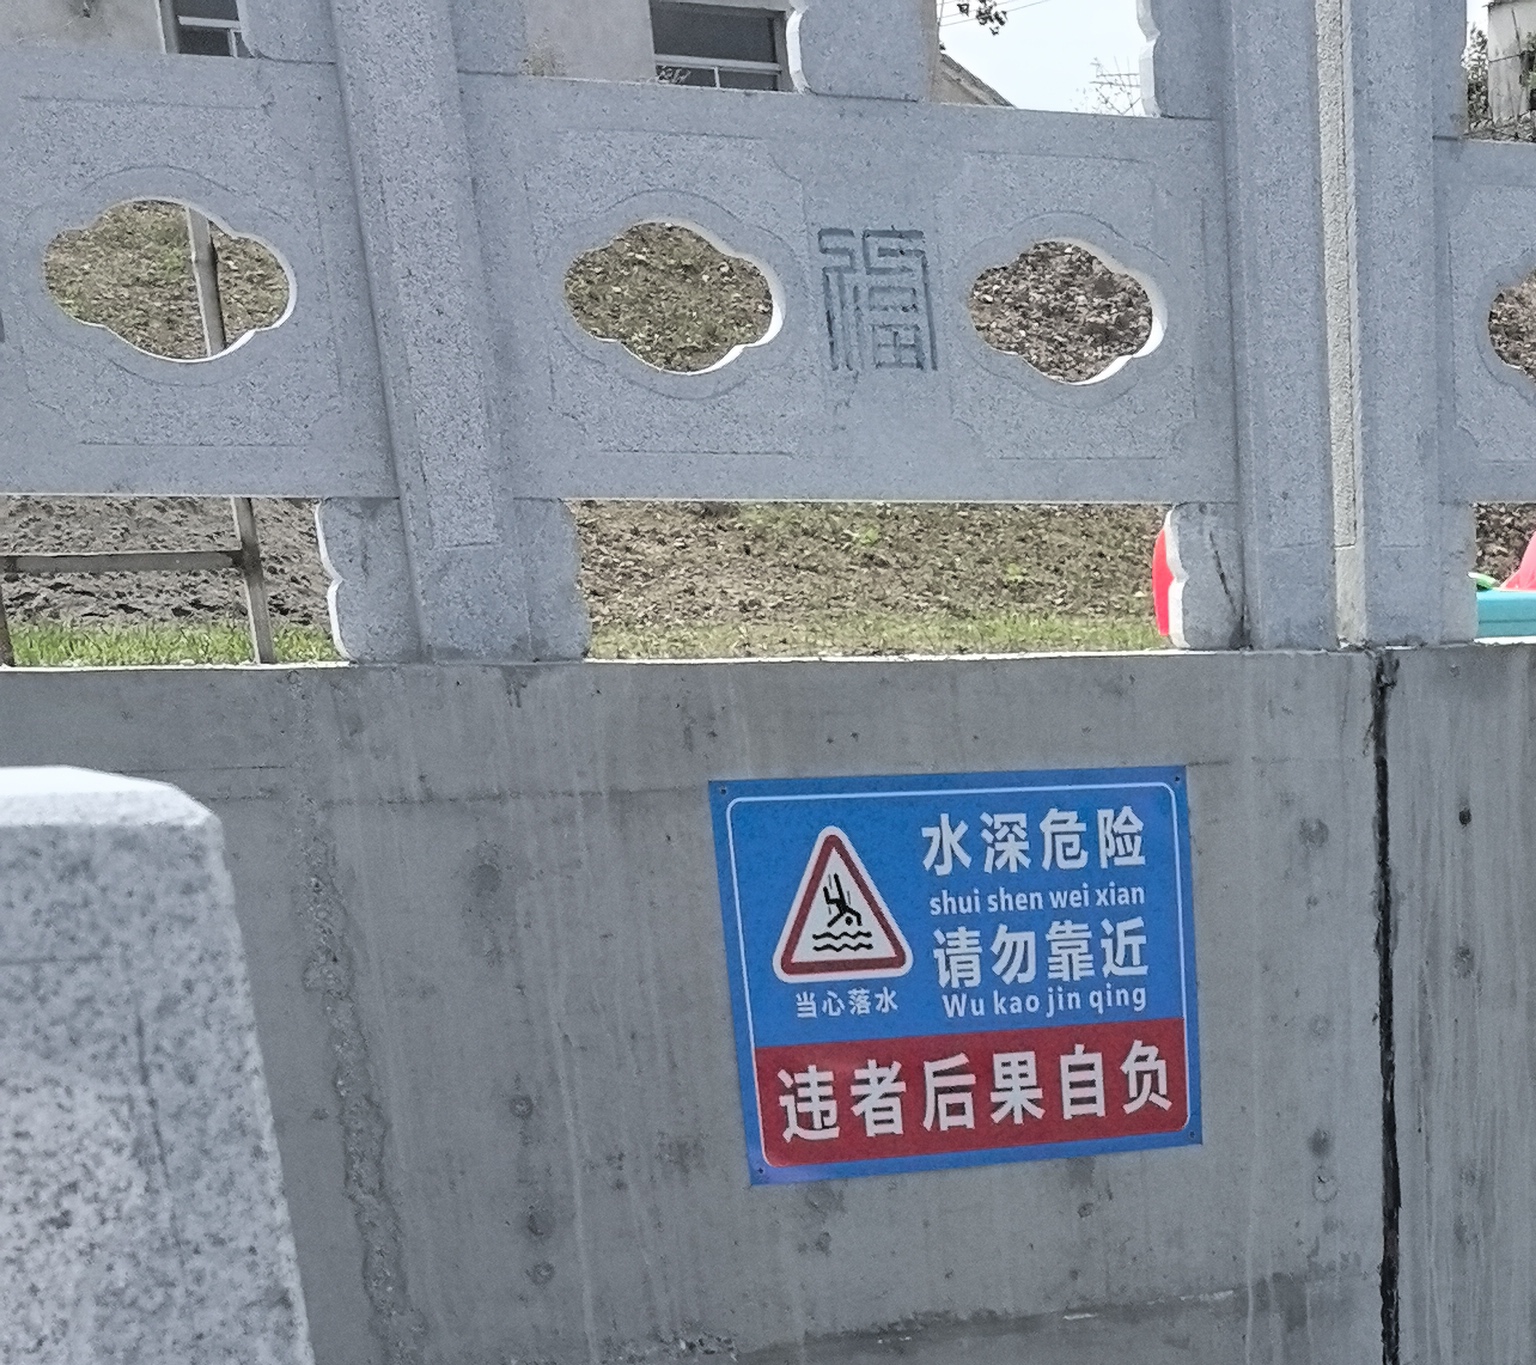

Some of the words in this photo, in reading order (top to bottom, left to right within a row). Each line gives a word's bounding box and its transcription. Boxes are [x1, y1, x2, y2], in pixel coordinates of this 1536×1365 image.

[921, 806, 1146, 876] 水深危险
[929, 888, 981, 916] shui
[987, 886, 1043, 912] shen
[1049, 882, 1090, 909] wei
[1094, 881, 1146, 907] xian
[933, 916, 1149, 988] 请勿靠近
[796, 986, 899, 1019] 当心落水
[941, 993, 985, 1018] Wu
[993, 990, 1040, 1015] kao
[1046, 986, 1081, 1018] jin
[1089, 983, 1147, 1014] qing
[777, 1039, 1173, 1144] 违者后果自负
